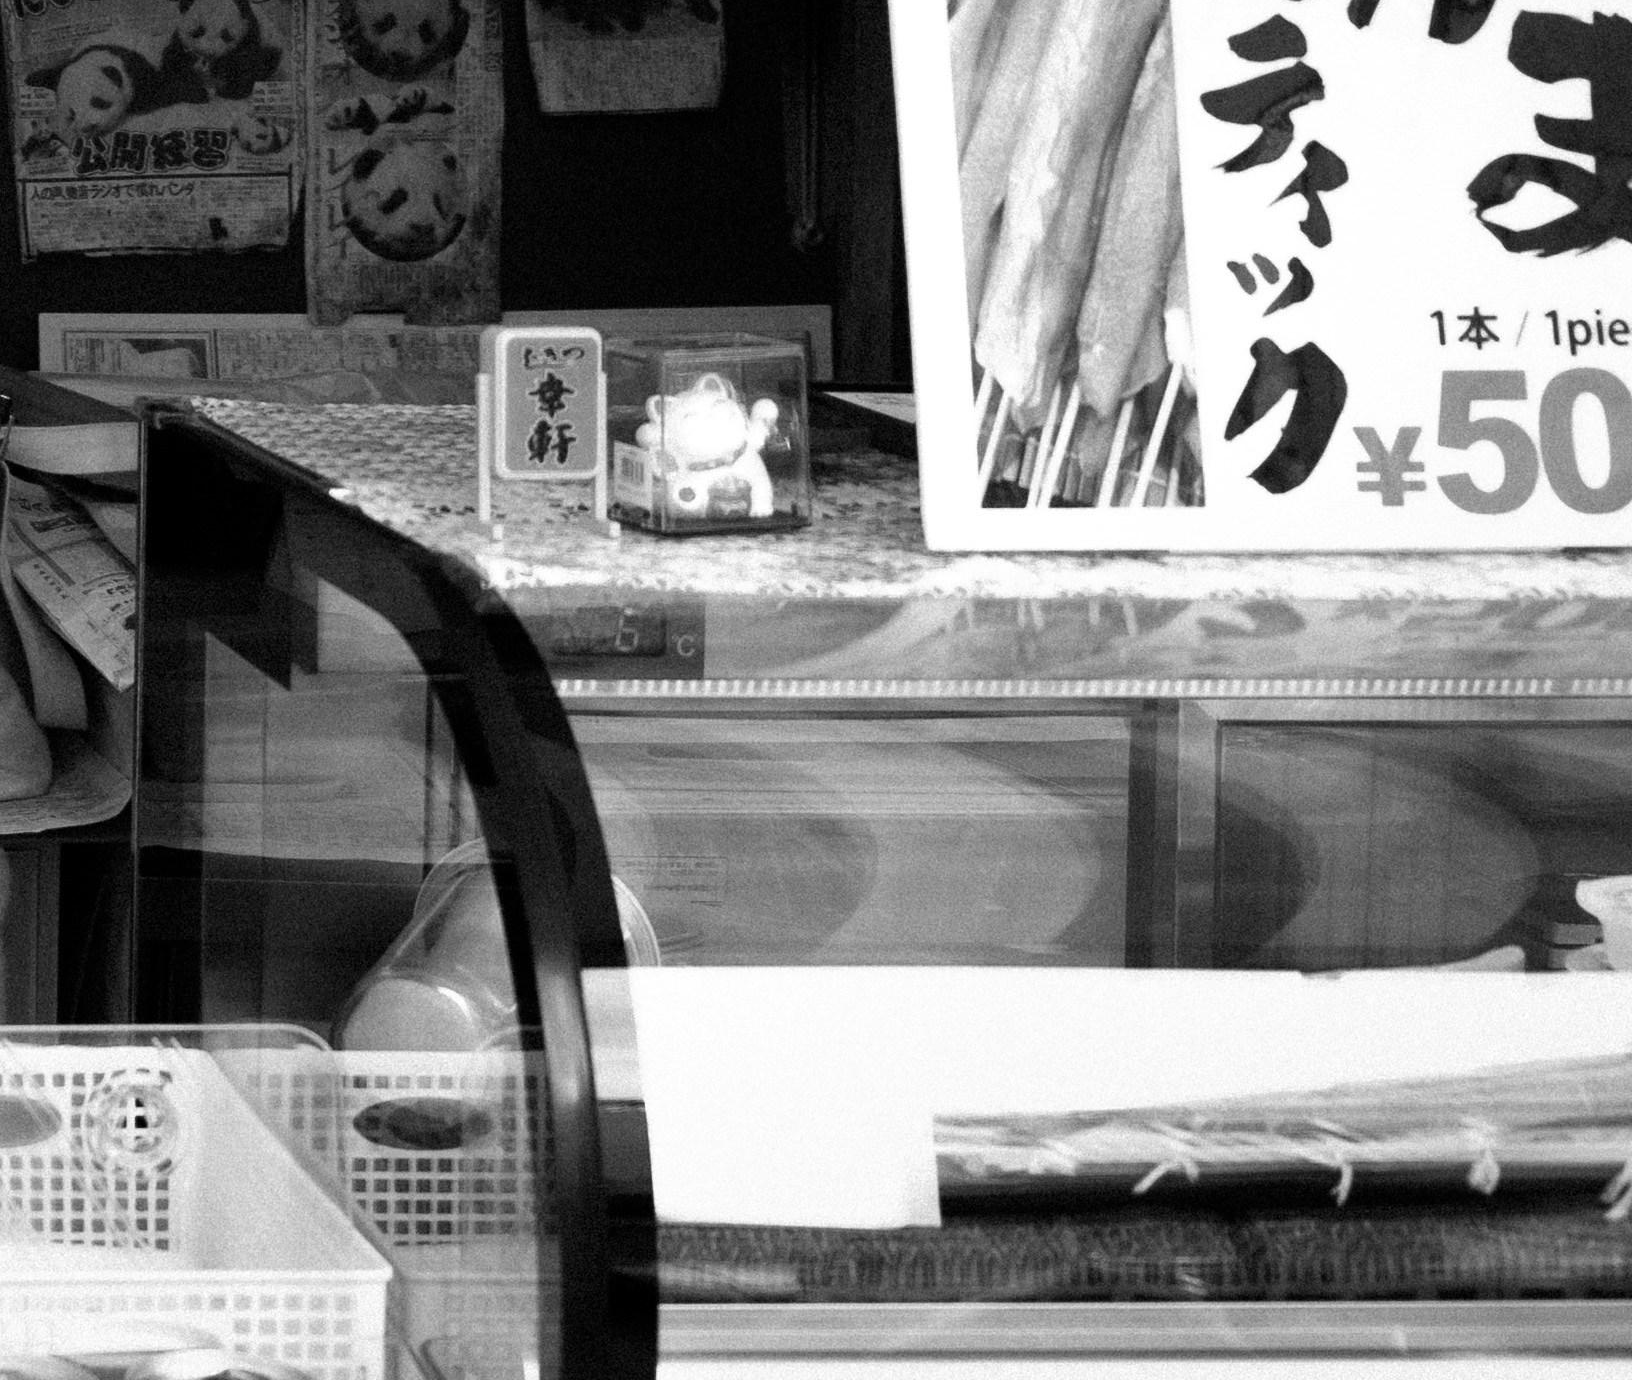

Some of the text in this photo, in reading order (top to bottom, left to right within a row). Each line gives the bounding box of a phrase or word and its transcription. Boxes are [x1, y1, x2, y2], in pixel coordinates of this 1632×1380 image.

[73, 129, 231, 173] 公開練習
[1430, 307, 1500, 350] 1本
[1352, 367, 1632, 515] ¥50
